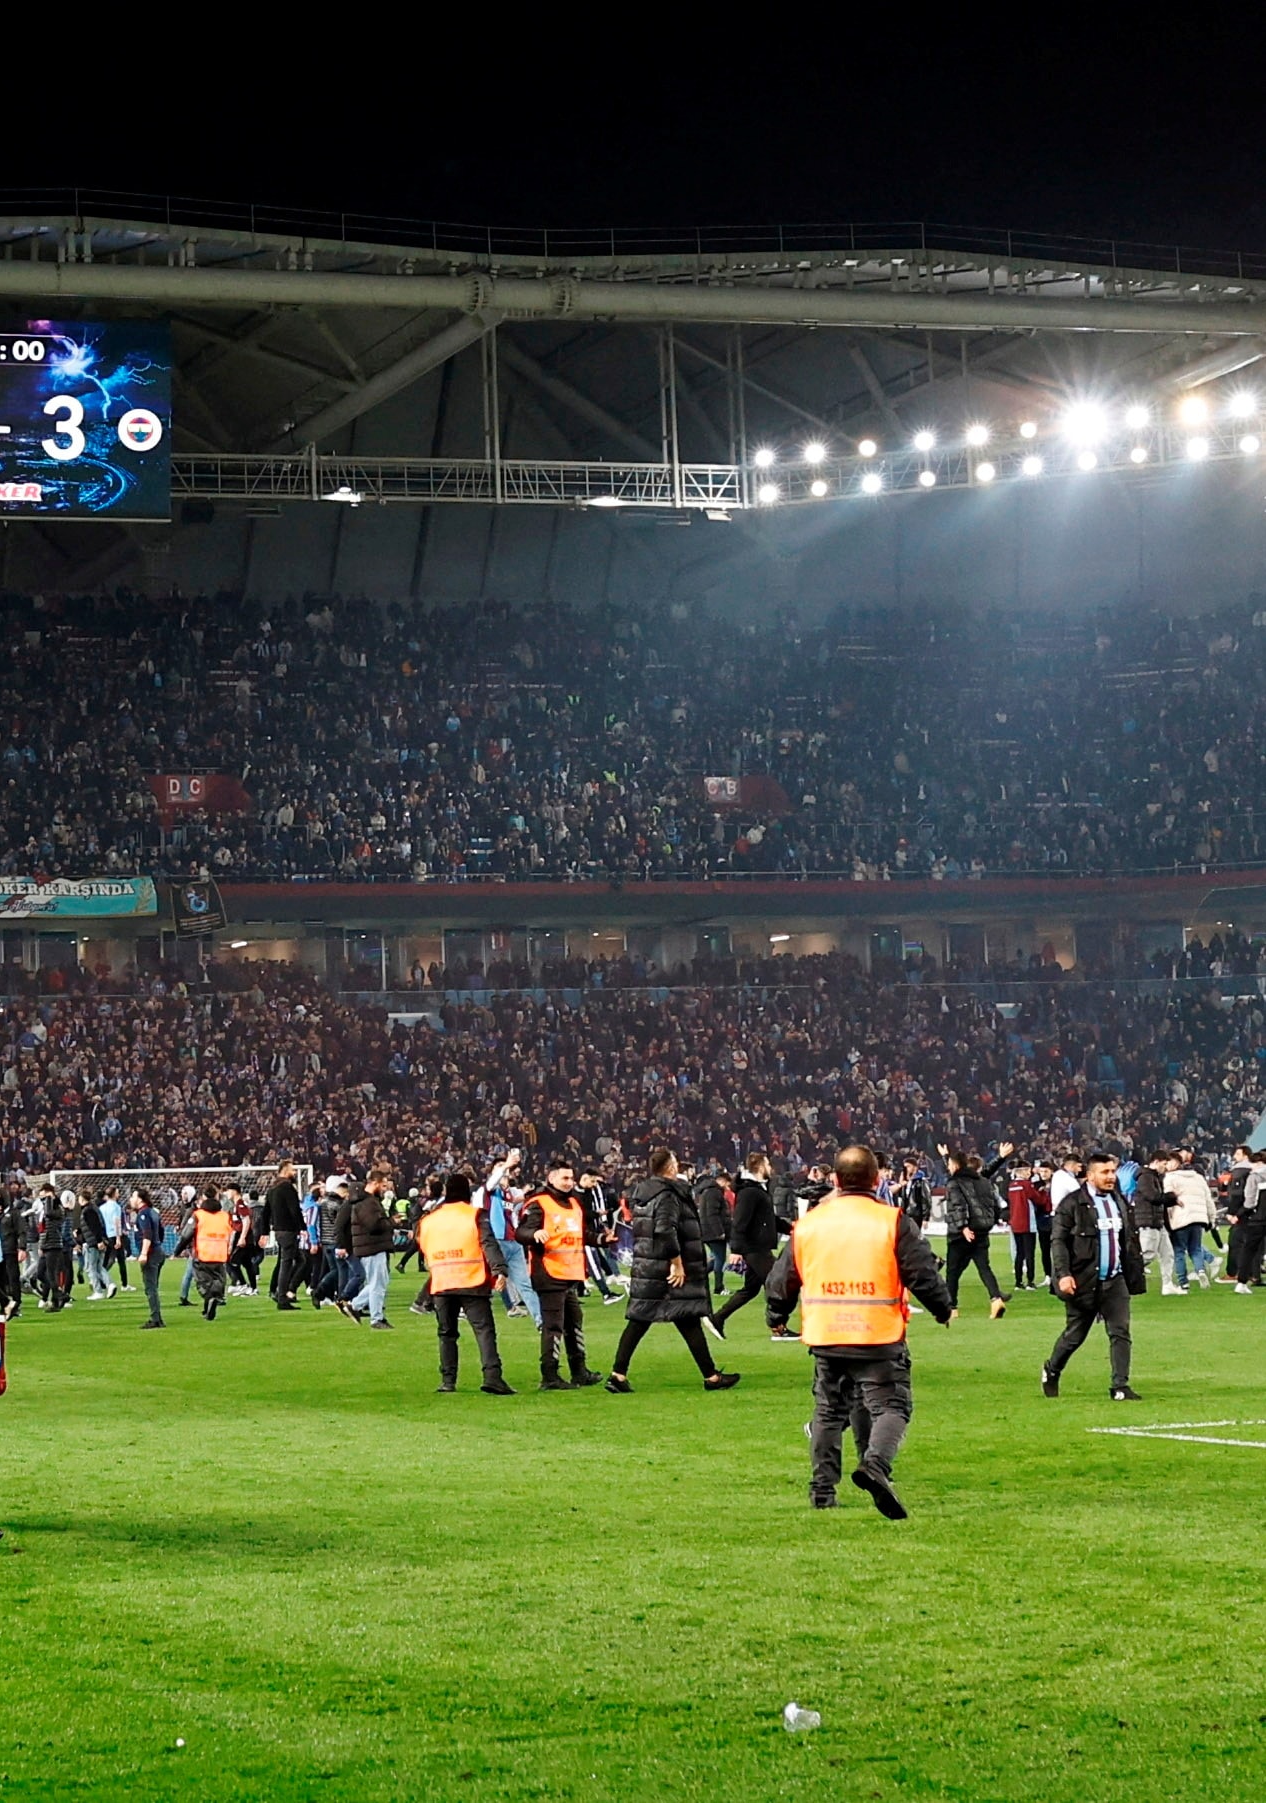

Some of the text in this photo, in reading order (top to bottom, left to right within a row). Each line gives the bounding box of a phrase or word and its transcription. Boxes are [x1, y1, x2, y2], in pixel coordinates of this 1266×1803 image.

[41, 394, 86, 461] 3
[169, 779, 201, 795] D C
[44, 882, 135, 900] KARŞINDA
[821, 1281, 876, 1296] 1432-1183
